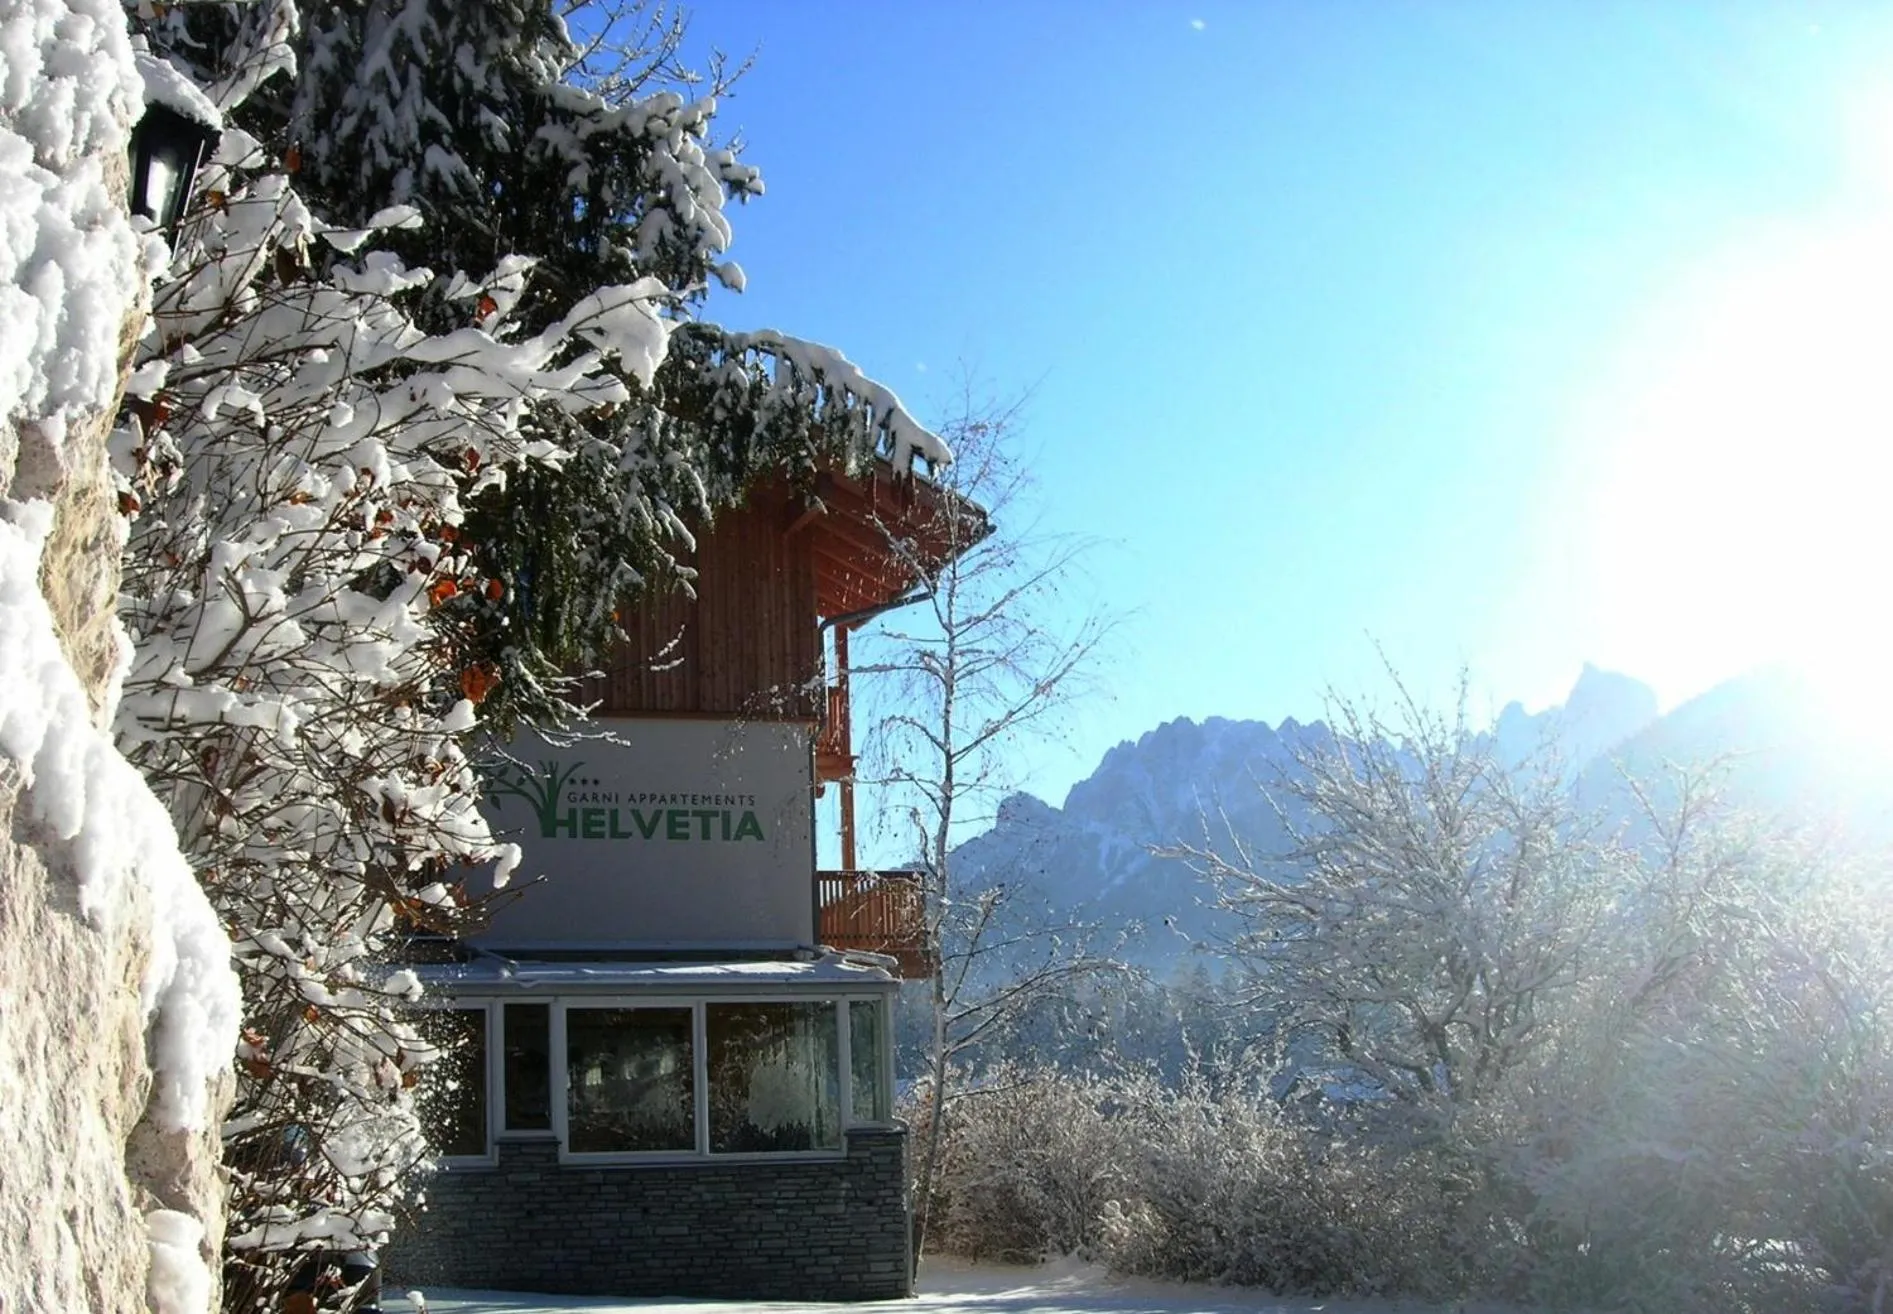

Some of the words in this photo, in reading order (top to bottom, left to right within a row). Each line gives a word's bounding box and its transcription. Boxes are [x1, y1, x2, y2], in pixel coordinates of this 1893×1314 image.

[567, 791, 619, 804] GARNI
[628, 792, 756, 806] APPARTEMENTS
[541, 807, 765, 841] HELVETIA
